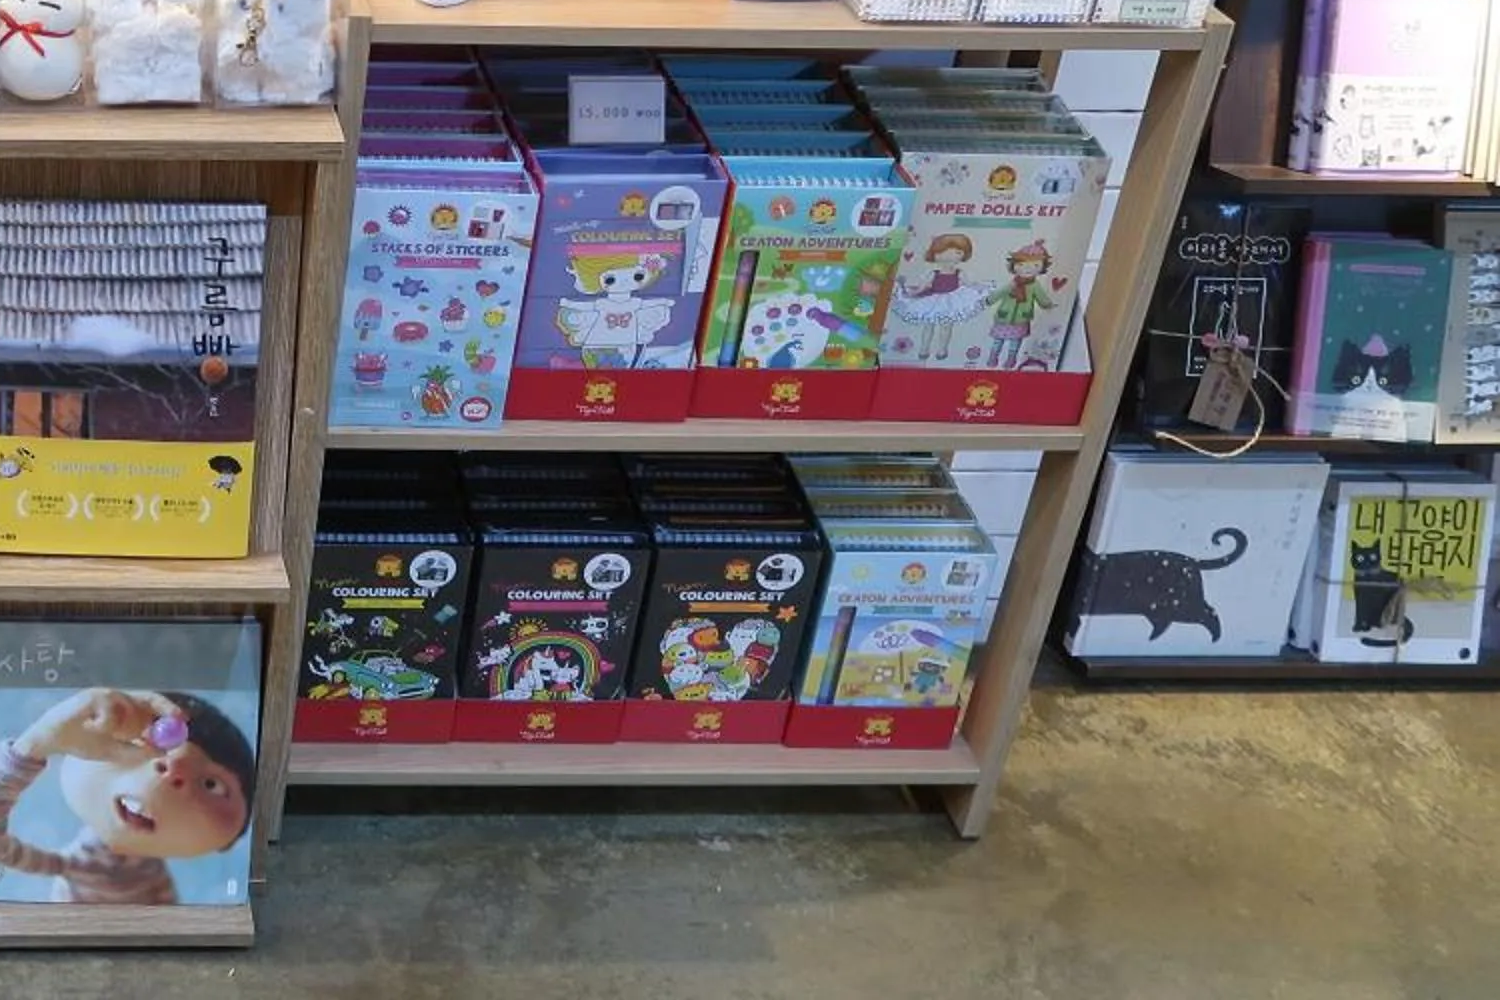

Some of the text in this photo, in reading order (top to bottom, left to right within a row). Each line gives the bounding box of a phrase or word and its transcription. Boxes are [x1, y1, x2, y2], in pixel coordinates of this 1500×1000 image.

[924, 202, 1067, 217] PAPER DOLLS KIT
[571, 230, 682, 243] COLOURING SET
[739, 236, 893, 250] CRAYON ADVENTURES
[371, 242, 510, 257] STACKS OF STICKERS
[1354, 500, 1387, 536] 내
[1386, 533, 1477, 579] 박먼지
[331, 586, 440, 599] COLOURING SET
[507, 590, 614, 601] COLOURING SET
[678, 591, 786, 602] COLOURING SET
[889, 593, 976, 606] ADVENTURES
